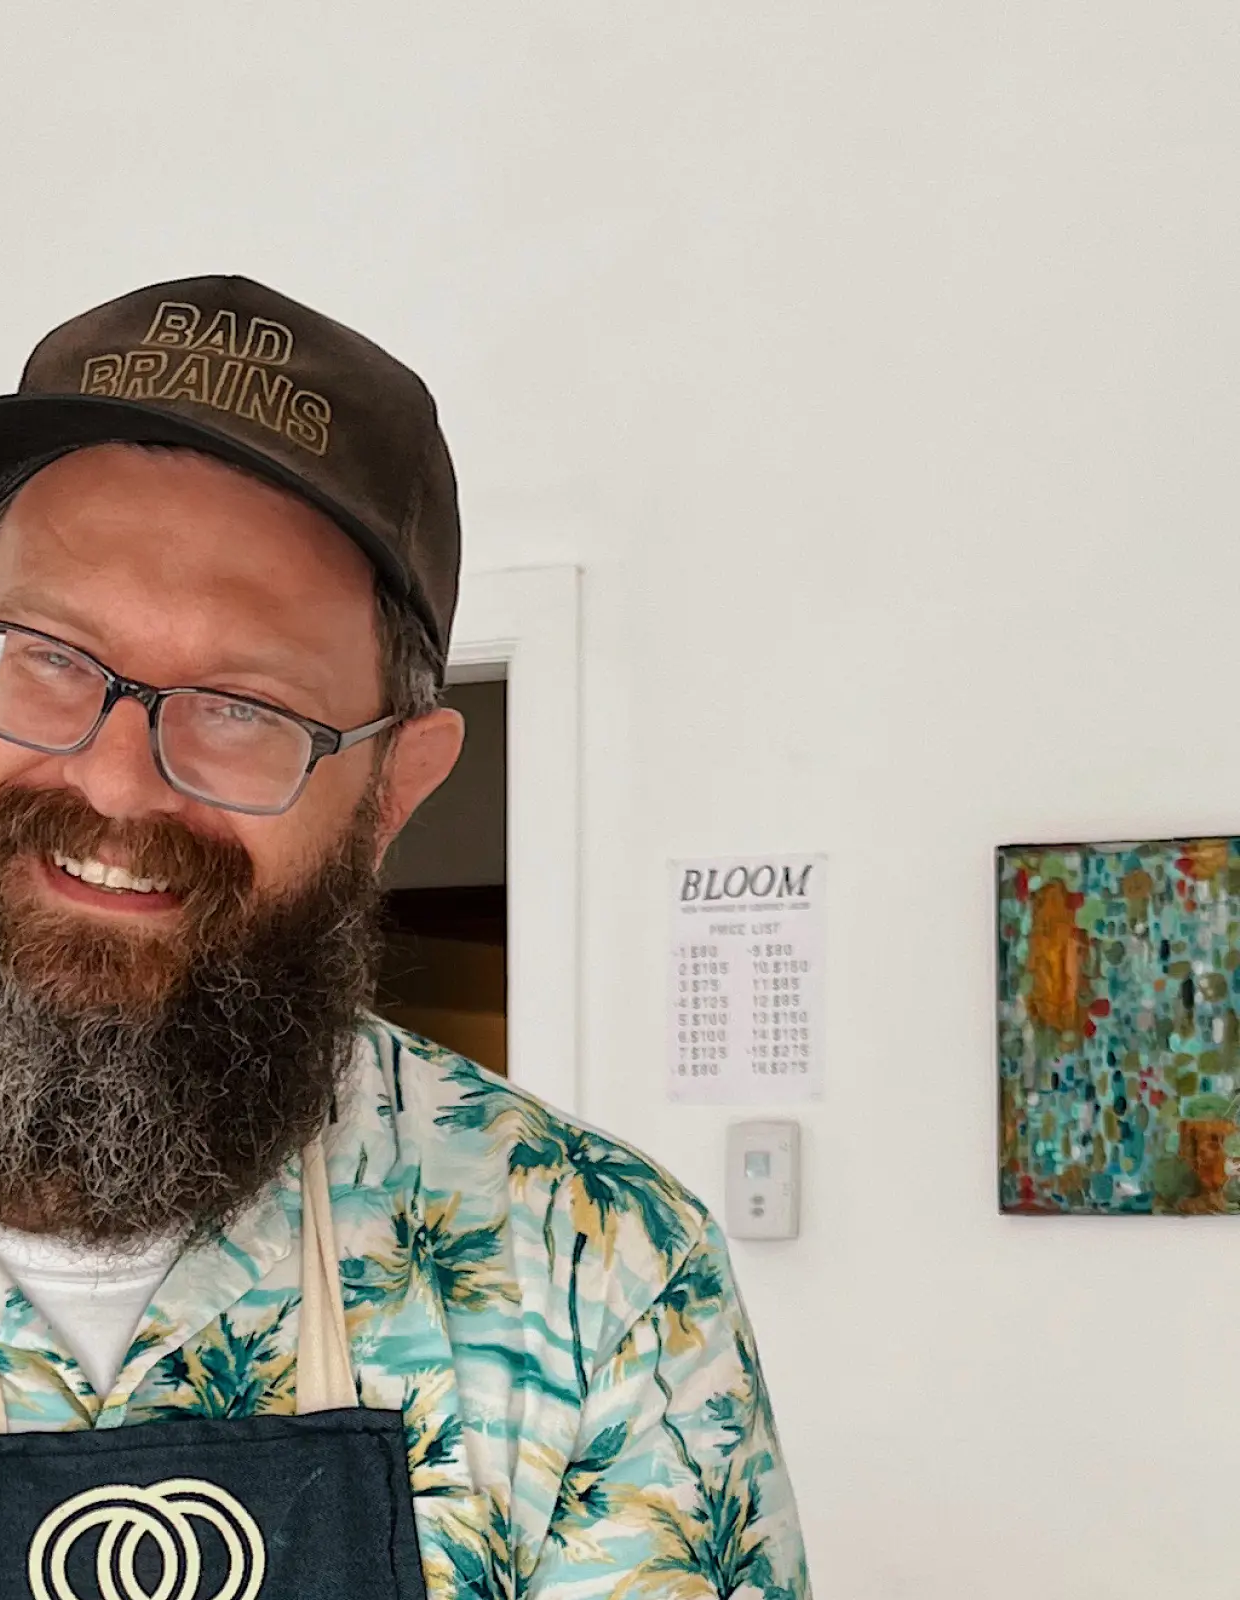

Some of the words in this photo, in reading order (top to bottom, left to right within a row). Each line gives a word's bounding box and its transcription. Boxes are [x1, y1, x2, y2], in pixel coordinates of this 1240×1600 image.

[141, 301, 293, 366] BAD
[79, 350, 333, 457] BRAINS
[680, 864, 813, 901] BLOOM
[709, 923, 746, 936] PRICE
[751, 921, 781, 935] LIST
